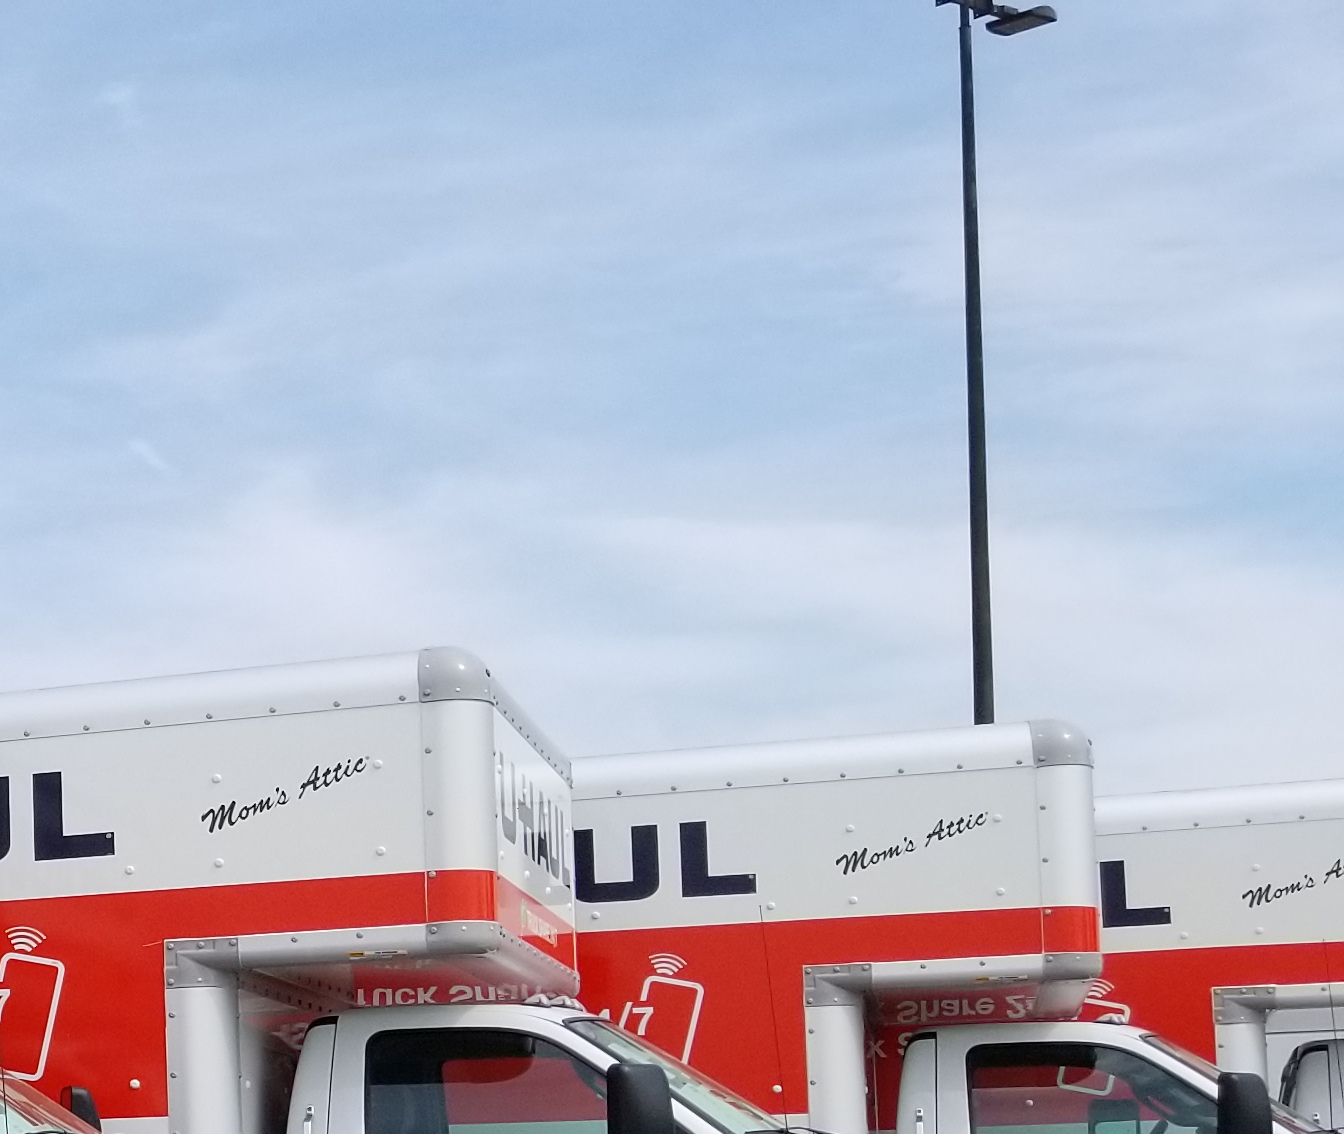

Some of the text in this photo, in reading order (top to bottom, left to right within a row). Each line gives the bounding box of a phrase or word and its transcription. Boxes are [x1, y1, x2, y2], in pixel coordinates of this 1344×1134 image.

[201, 756, 367, 835] Mom's Attic
[835, 811, 989, 876] Mom's Attic
[1241, 873, 1316, 909] Mom's
